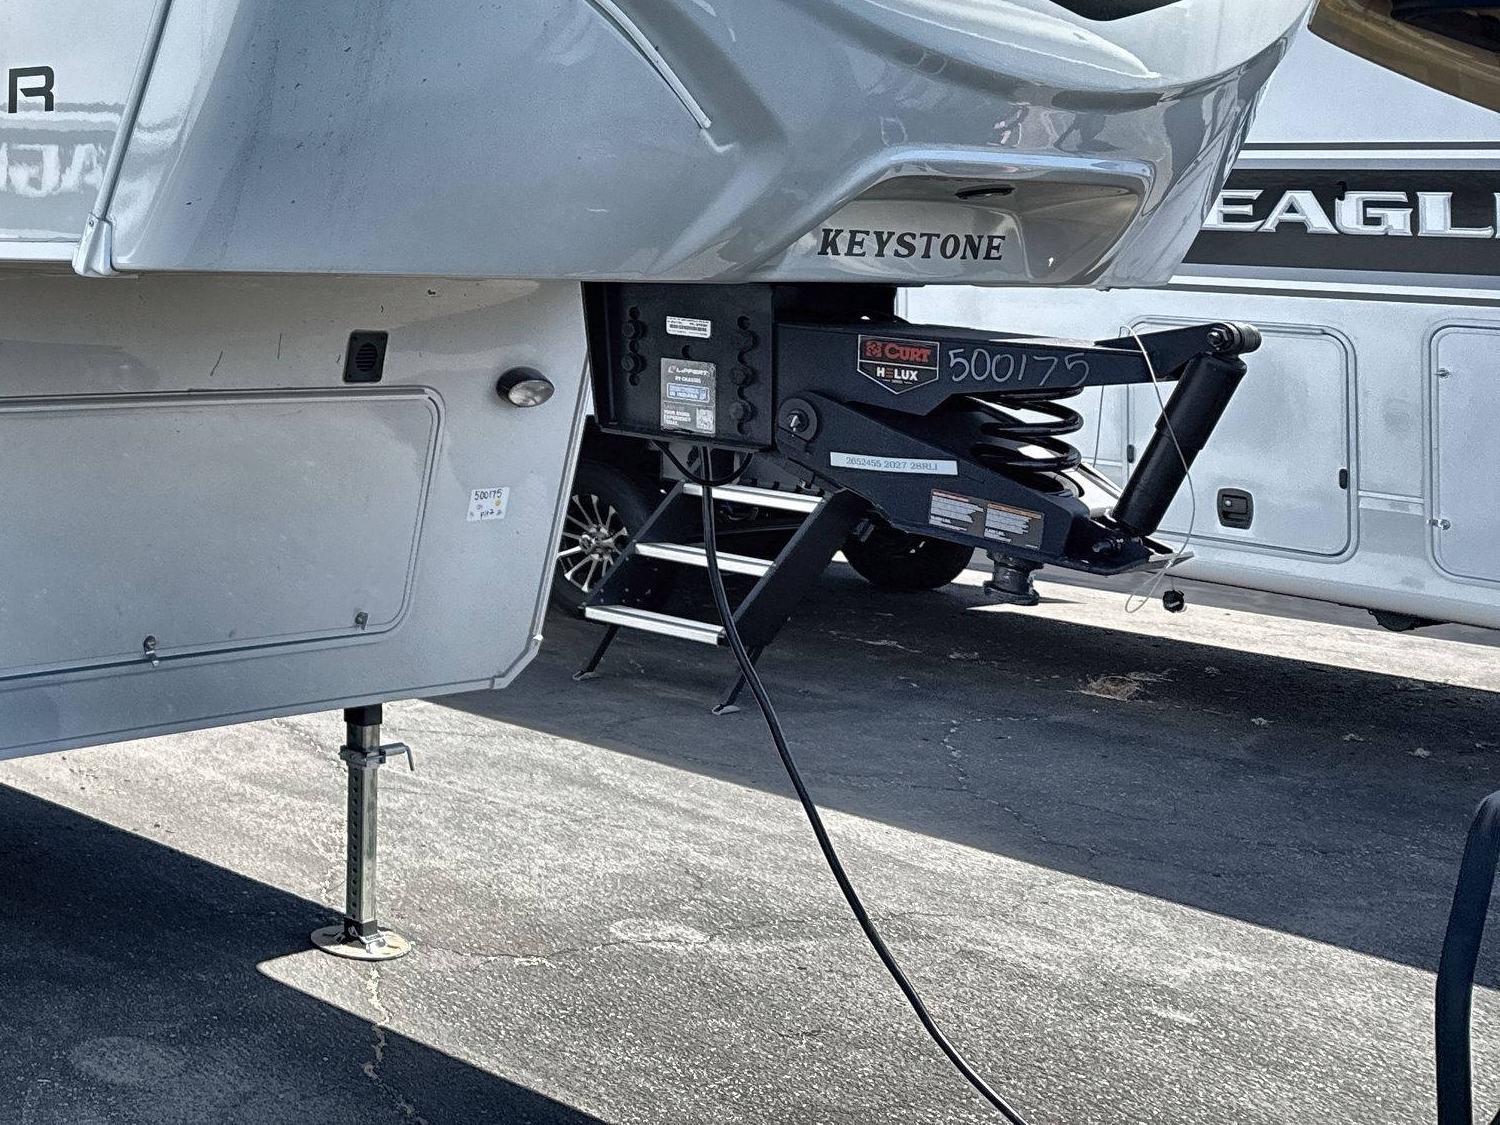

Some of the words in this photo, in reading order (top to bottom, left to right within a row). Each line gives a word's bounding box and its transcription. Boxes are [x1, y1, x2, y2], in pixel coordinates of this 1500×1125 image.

[1200, 189, 1500, 239] EAGL
[817, 228, 1006, 260] KEYSTONE
[884, 342, 931, 363] CURT
[876, 366, 918, 381] HELUX
[948, 348, 1090, 388] 500175
[474, 489, 503, 500] 500175
